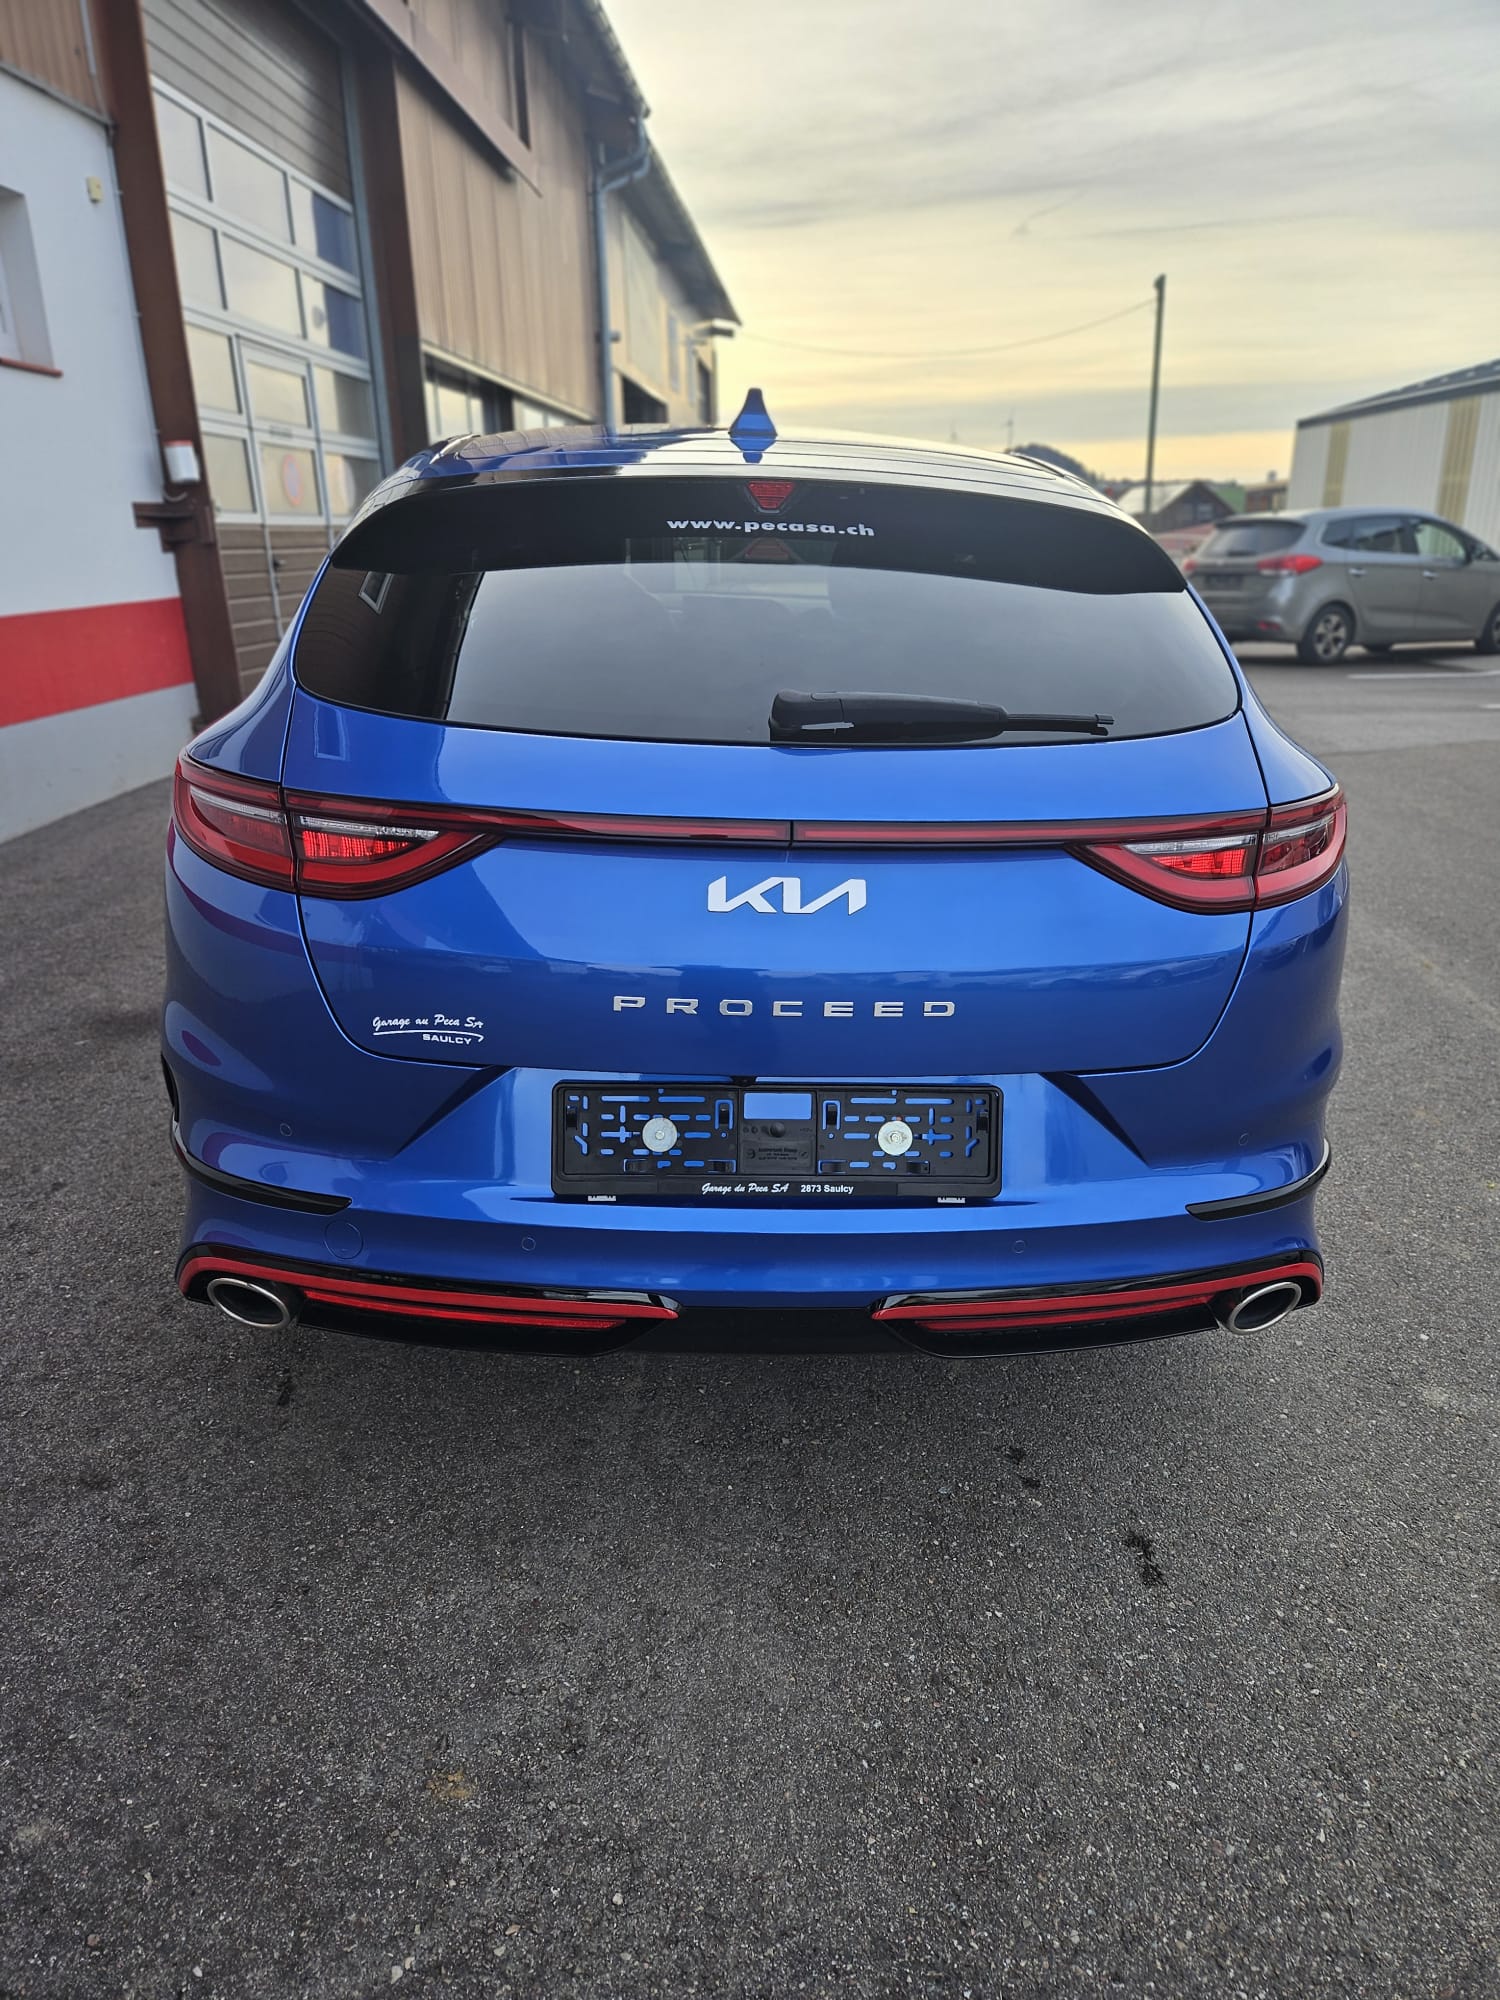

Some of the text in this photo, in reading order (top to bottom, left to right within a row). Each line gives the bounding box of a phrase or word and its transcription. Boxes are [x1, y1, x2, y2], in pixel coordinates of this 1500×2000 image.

[666, 519, 875, 537] www.pecasa.ch
[707, 876, 867, 915] KIA
[613, 995, 955, 1017] PROCEED
[372, 1016, 411, 1031] Garage
[434, 1014, 460, 1026] Peca
[422, 1033, 472, 1045] SAULCY
[701, 1182, 854, 1195] Garage du Peca SA 2873 Saulcy
